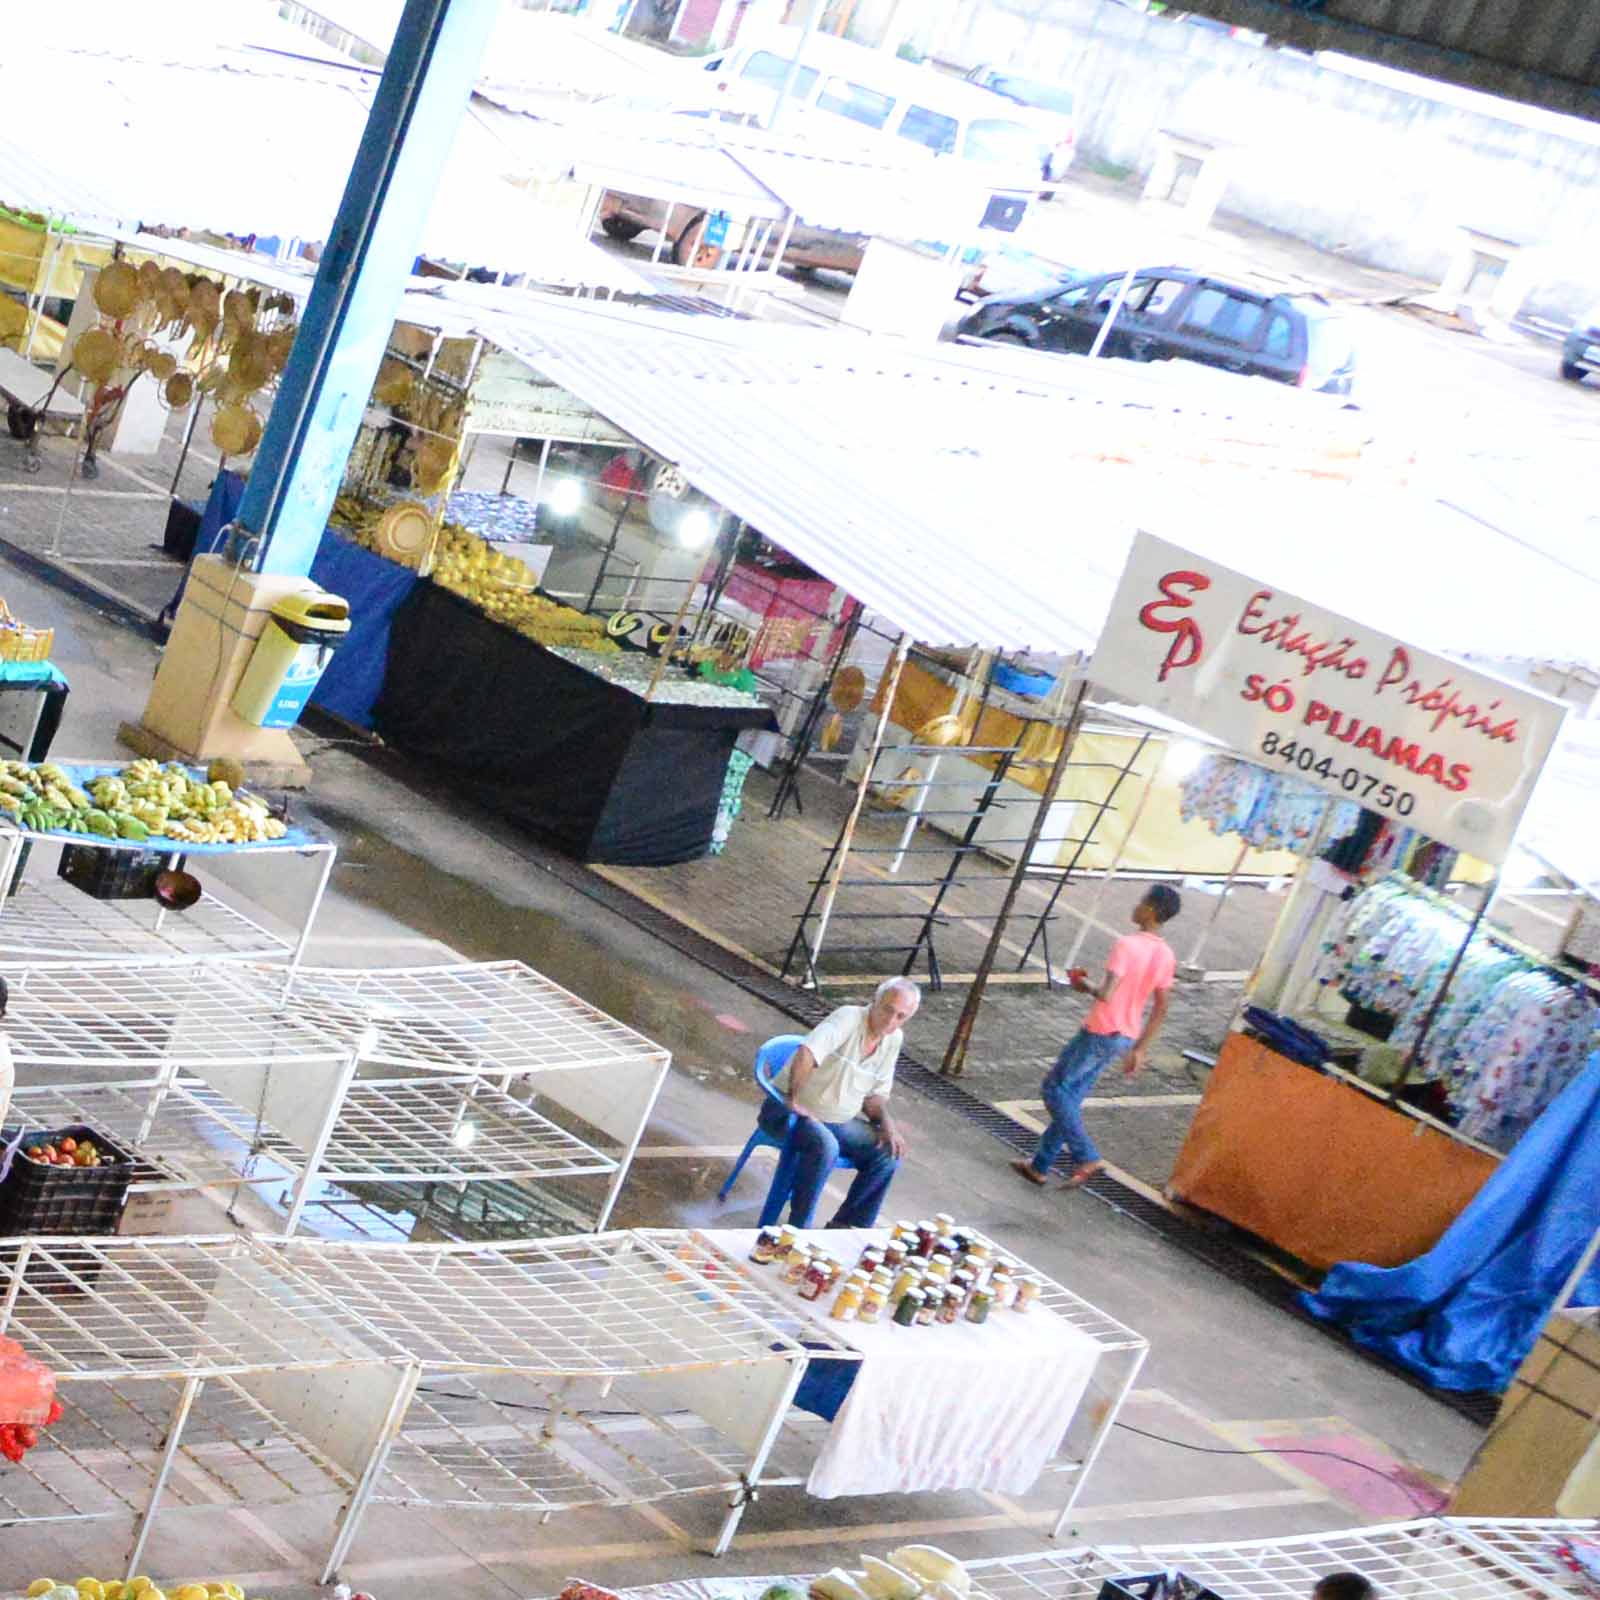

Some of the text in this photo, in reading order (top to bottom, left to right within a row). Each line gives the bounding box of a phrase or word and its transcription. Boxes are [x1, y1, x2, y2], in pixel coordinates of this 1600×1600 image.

[1240, 673, 1471, 792] SÓ PIJAMAS
[1261, 731, 1416, 816] 8404-0750
